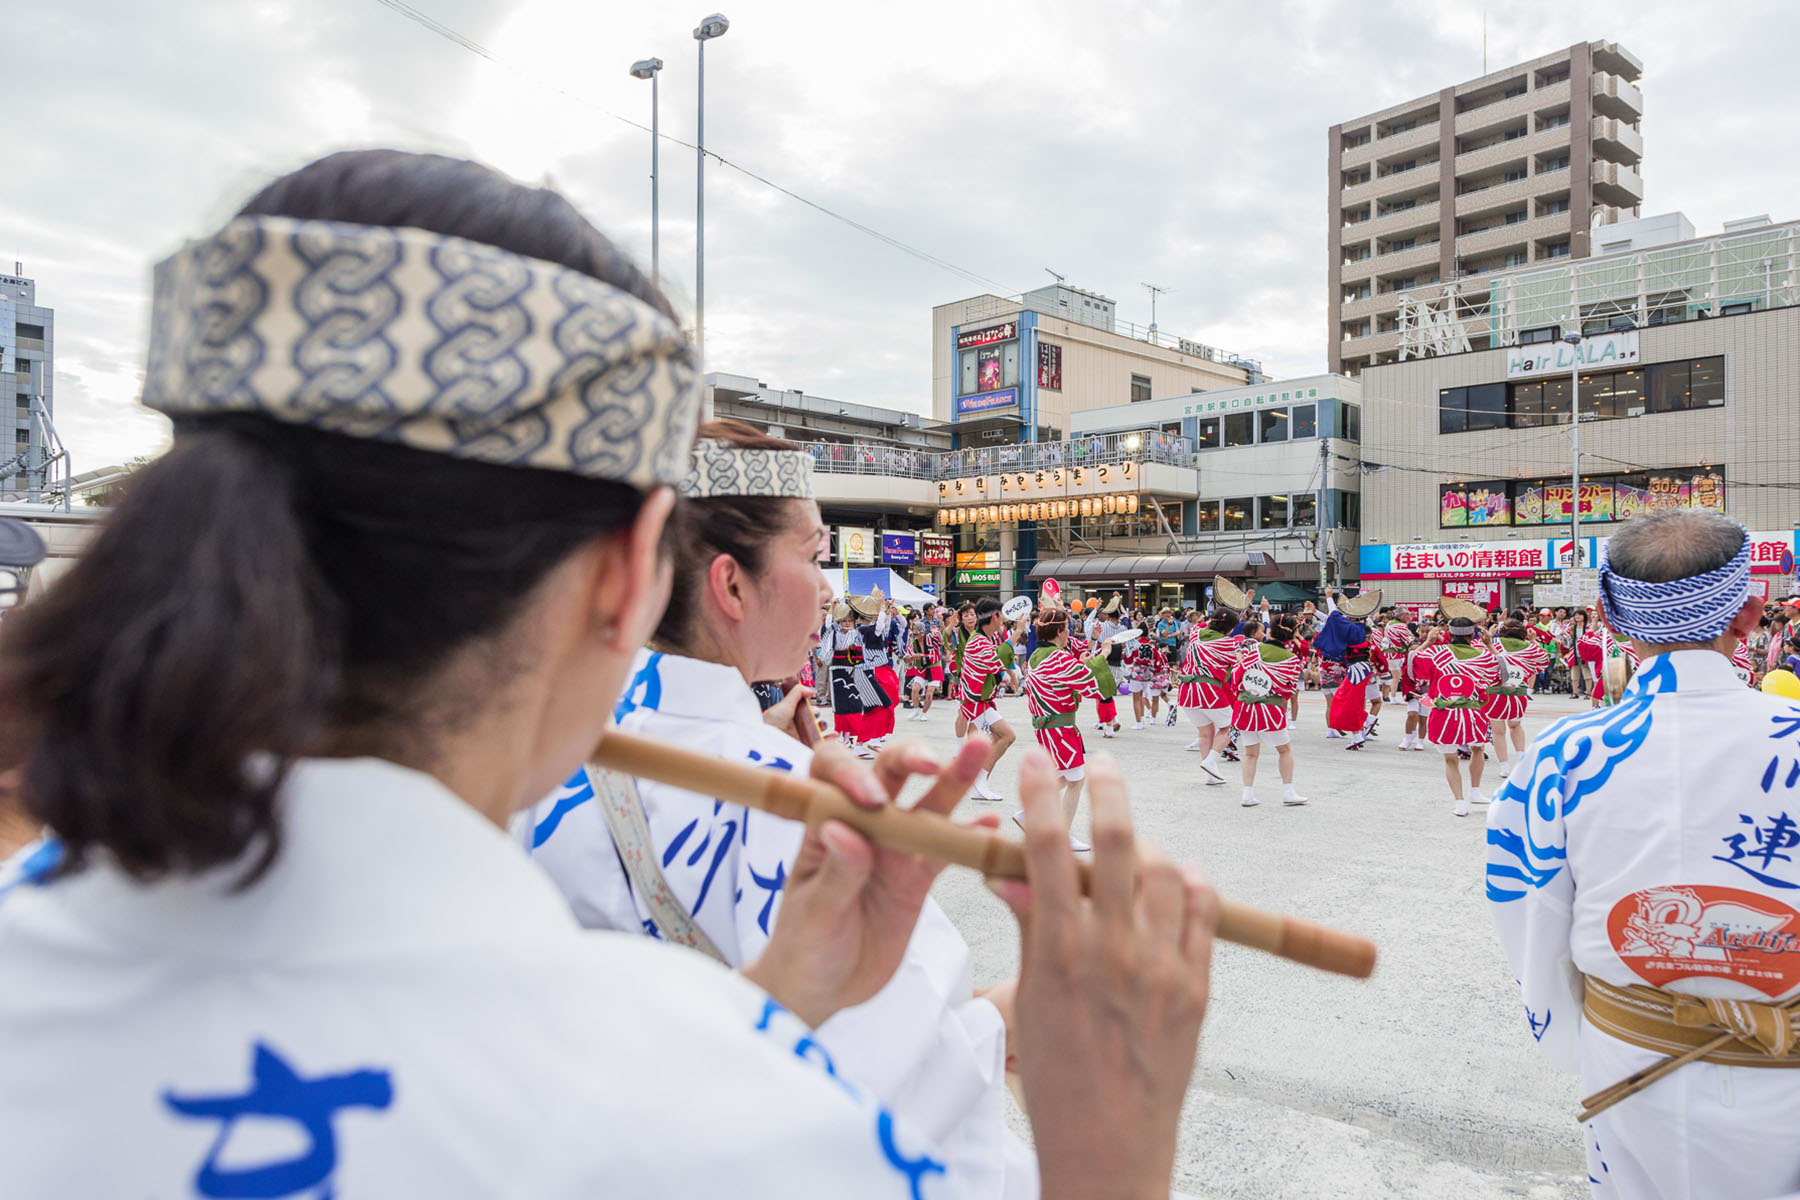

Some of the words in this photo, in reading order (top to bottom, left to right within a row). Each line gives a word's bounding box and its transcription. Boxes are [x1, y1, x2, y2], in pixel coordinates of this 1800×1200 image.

[982, 324, 1013, 342] はなの舞
[1510, 354, 1551, 373] Hair
[1556, 340, 1617, 368] LALA
[1184, 389, 1317, 414] 宮原駅東口自転車駐車場
[1545, 486, 1612, 500] ドリンクバー
[1651, 480, 1680, 494] 30分
[1442, 490, 1505, 525] カラオケ
[1561, 500, 1592, 514] 無料
[924, 547, 951, 561] はなの舞
[1395, 549, 1542, 570] 住まいの情報館
[1560, 554, 1583, 562] ER
[987, 573, 1000, 581] BUR
[1446, 582, 1498, 594] 賃貸・売買
